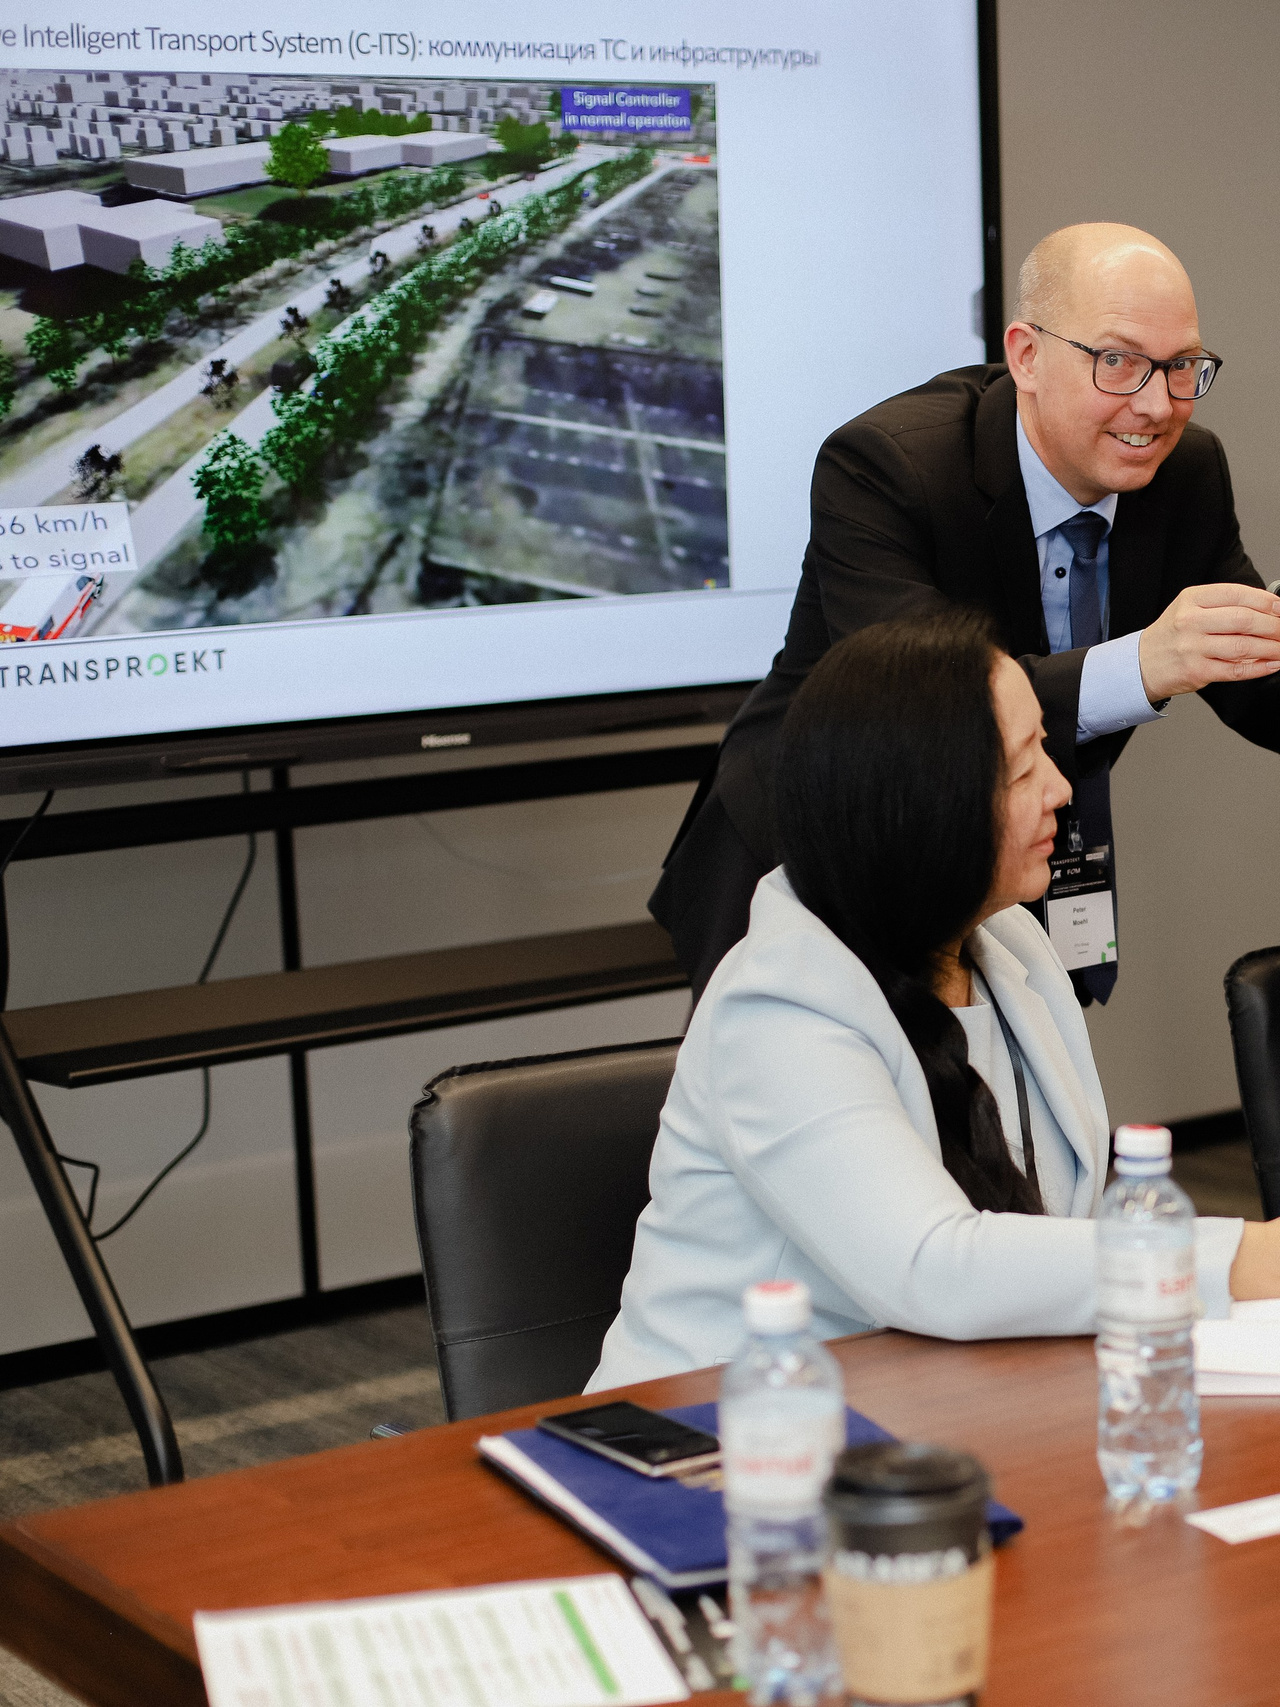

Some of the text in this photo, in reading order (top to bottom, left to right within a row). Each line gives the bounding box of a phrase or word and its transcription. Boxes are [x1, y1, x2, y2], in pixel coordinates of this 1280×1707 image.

[0, 29, 16, 47] e
[23, 23, 141, 54] Intelligent
[144, 26, 257, 56] Transport
[262, 29, 343, 58] System
[348, 30, 424, 60] (C-ITS):
[428, 37, 596, 64] коммуникация
[631, 45, 644, 60] и
[649, 40, 821, 71] инфраструктуры
[573, 91, 681, 109] Signal Controller
[564, 112, 690, 130] in normal operation
[34, 511, 108, 533] km/h
[10, 544, 130, 570] to signal
[0, 649, 227, 688] TRANSPROEKT
